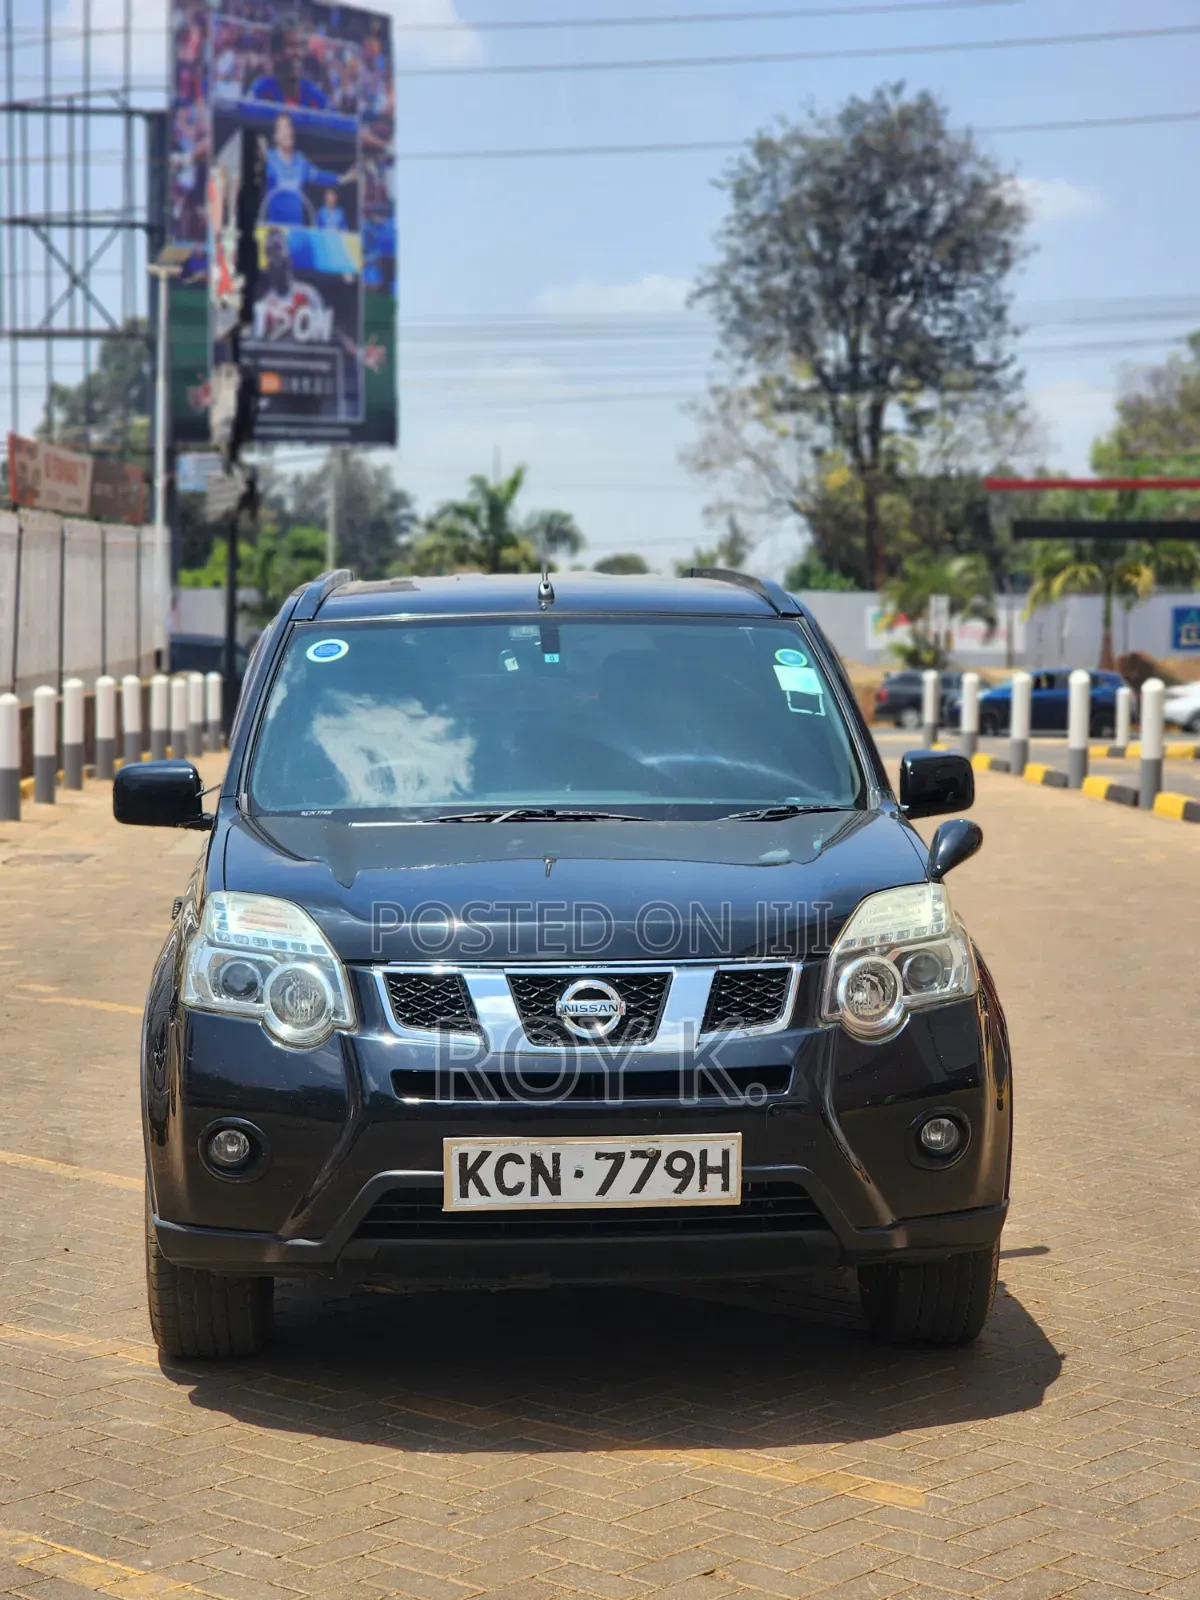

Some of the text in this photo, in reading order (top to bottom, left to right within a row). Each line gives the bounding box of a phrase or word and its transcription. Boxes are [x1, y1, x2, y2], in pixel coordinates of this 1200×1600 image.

[564, 1003, 619, 1013] NISSAN
[458, 1147, 731, 1198] KCN 779H
